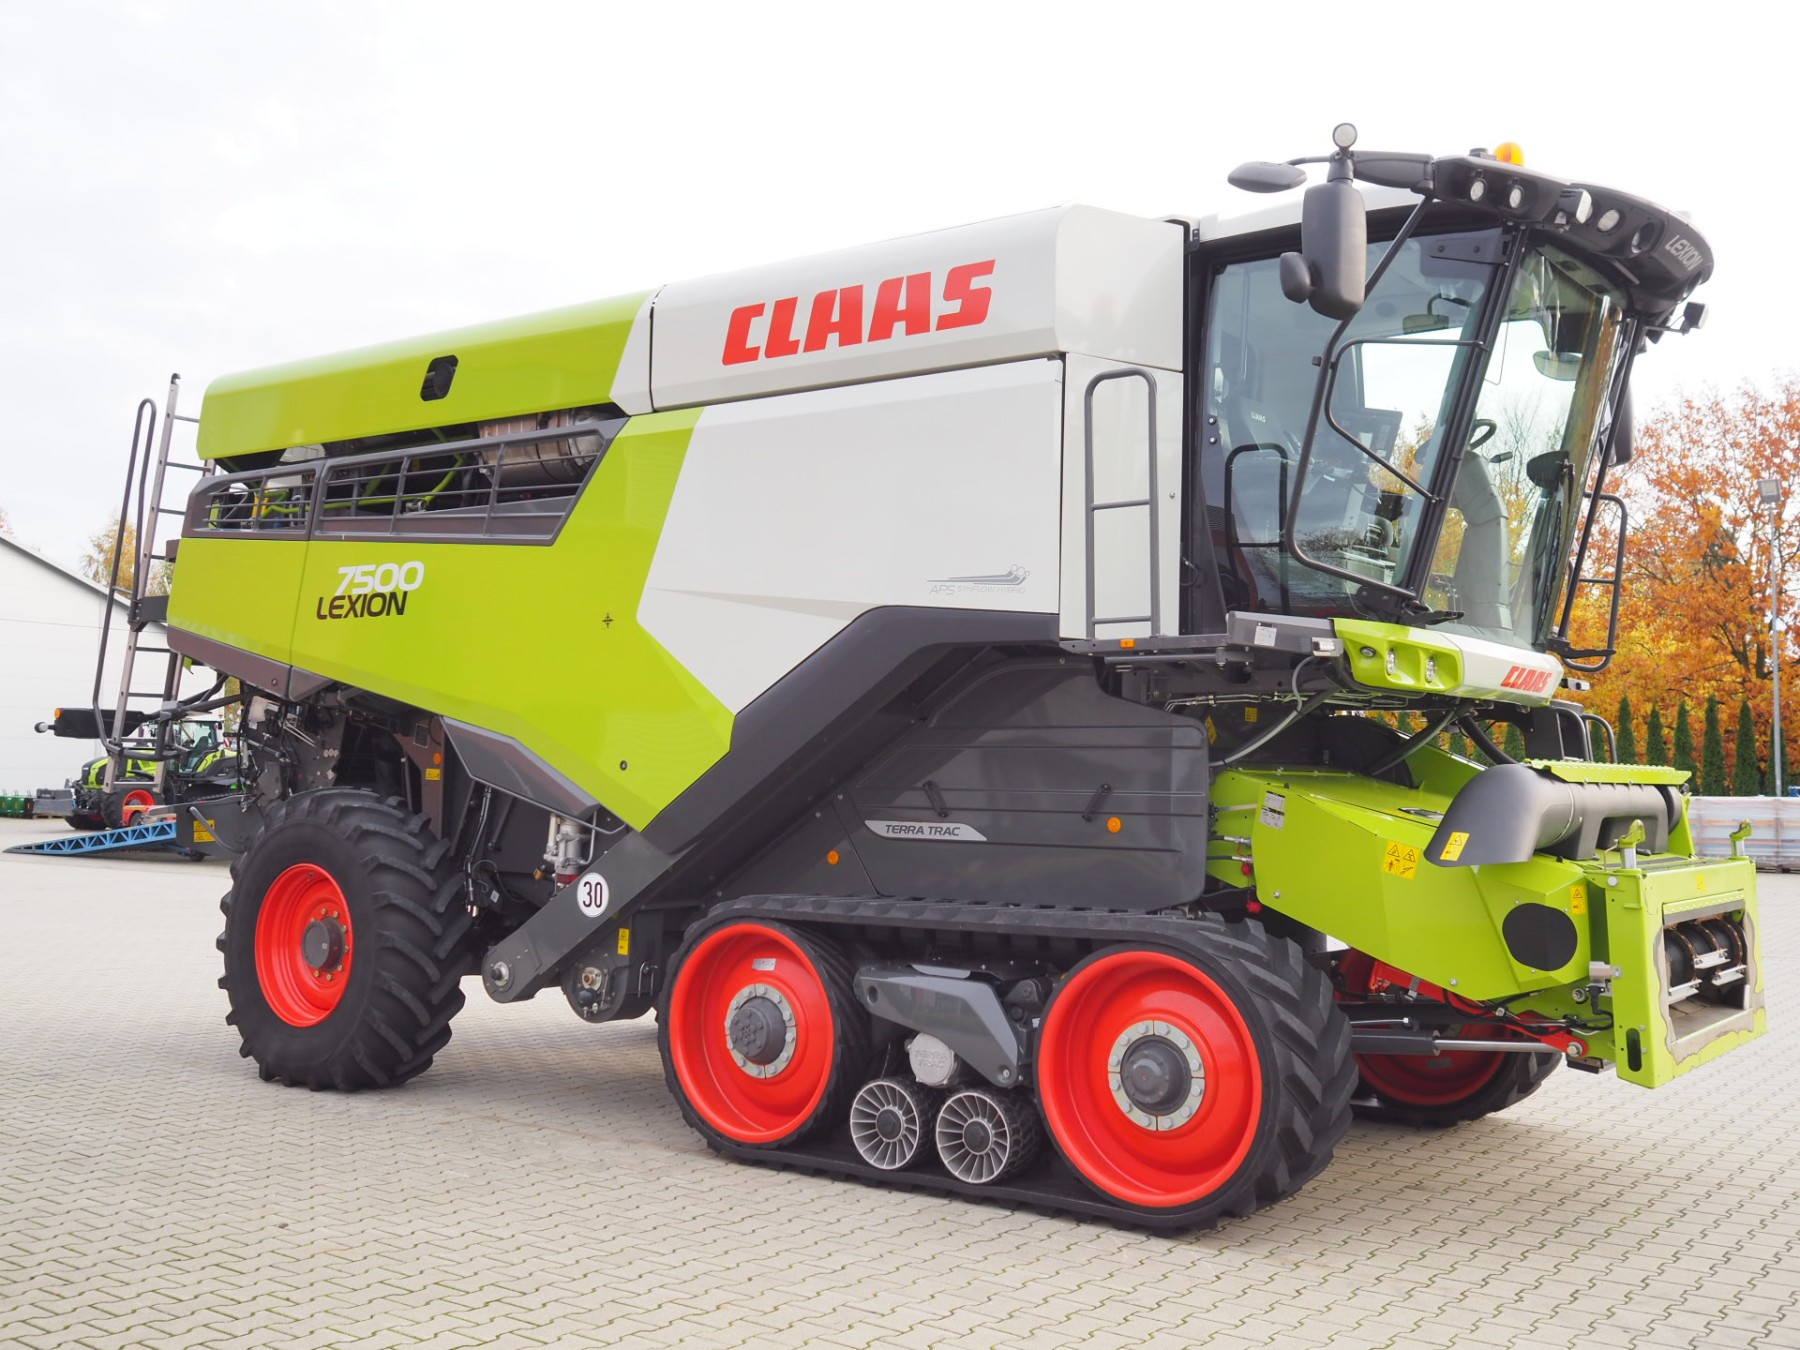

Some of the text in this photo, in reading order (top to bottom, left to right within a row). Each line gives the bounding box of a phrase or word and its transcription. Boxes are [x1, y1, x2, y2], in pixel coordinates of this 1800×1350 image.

[1665, 235, 1703, 270] LEXION
[722, 259, 996, 366] CLAAS
[335, 561, 425, 596] 7500
[929, 584, 955, 595] APS
[316, 591, 408, 620] LEXION
[1501, 665, 1552, 693] CLAAS
[885, 824, 960, 836] TERRA TRAC
[583, 881, 603, 908] 30
